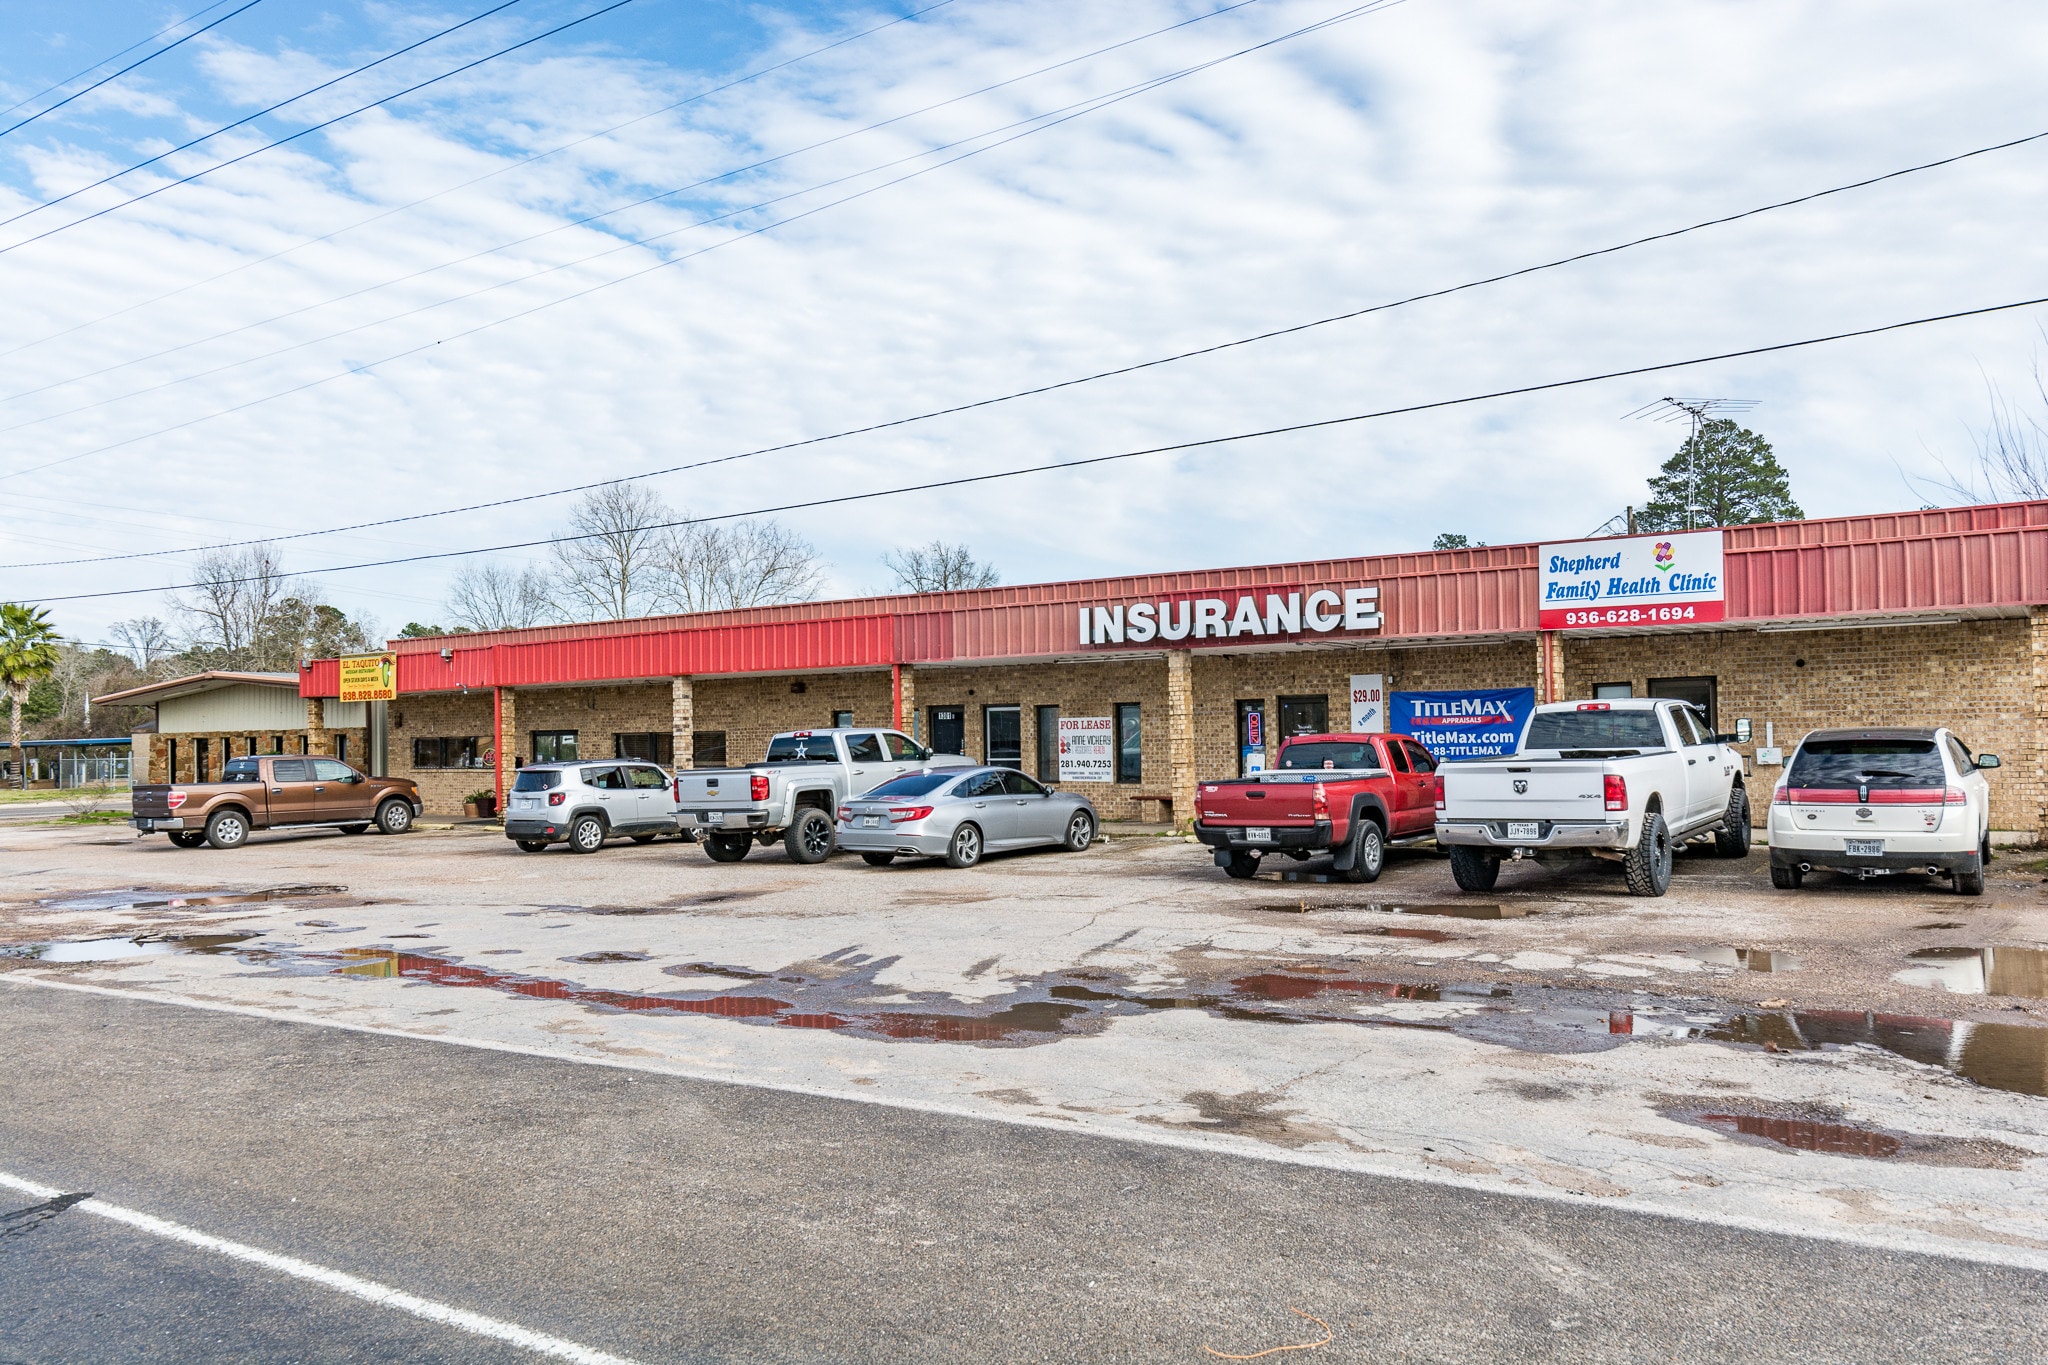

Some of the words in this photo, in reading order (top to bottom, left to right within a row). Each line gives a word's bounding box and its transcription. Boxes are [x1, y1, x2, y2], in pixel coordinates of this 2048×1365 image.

[1549, 552, 1621, 574] Shepherd
[1545, 580, 1600, 601] Family
[1607, 576, 1661, 595] Health
[1669, 572, 1717, 591] Clinic
[1079, 587, 1380, 645] INSURANCE
[1565, 606, 1695, 625] 936-628-1694
[1353, 689, 1380, 703] $29.00
[1060, 720, 1079, 729] FOR
[1081, 720, 1111, 729] LEASE
[1411, 731, 1514, 744] TitleMax.com
[1061, 760, 1111, 768] 281.940.7253
